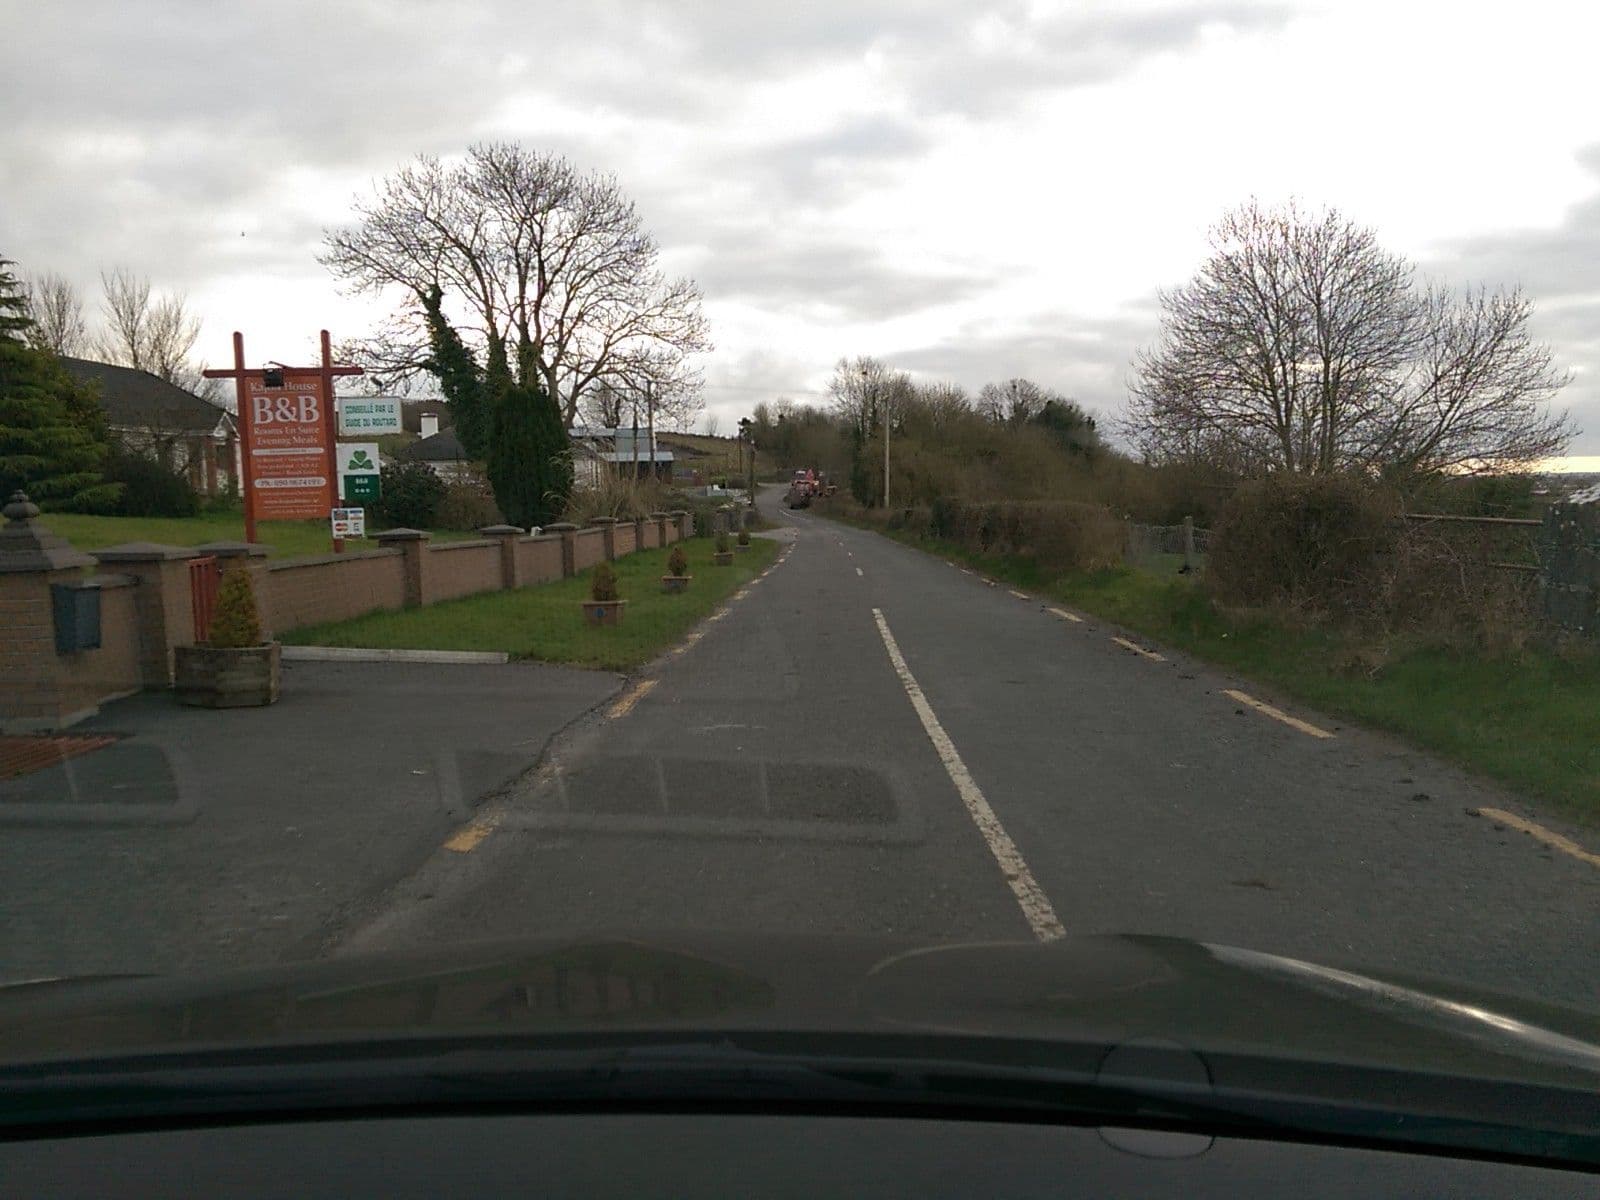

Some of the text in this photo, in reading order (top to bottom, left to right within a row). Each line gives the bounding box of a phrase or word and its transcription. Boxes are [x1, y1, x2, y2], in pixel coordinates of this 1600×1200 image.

[284, 382, 318, 391] House
[253, 395, 320, 424] B&B
[375, 404, 386, 413] PAR
[387, 404, 394, 413] LE
[292, 435, 318, 444] Meals
